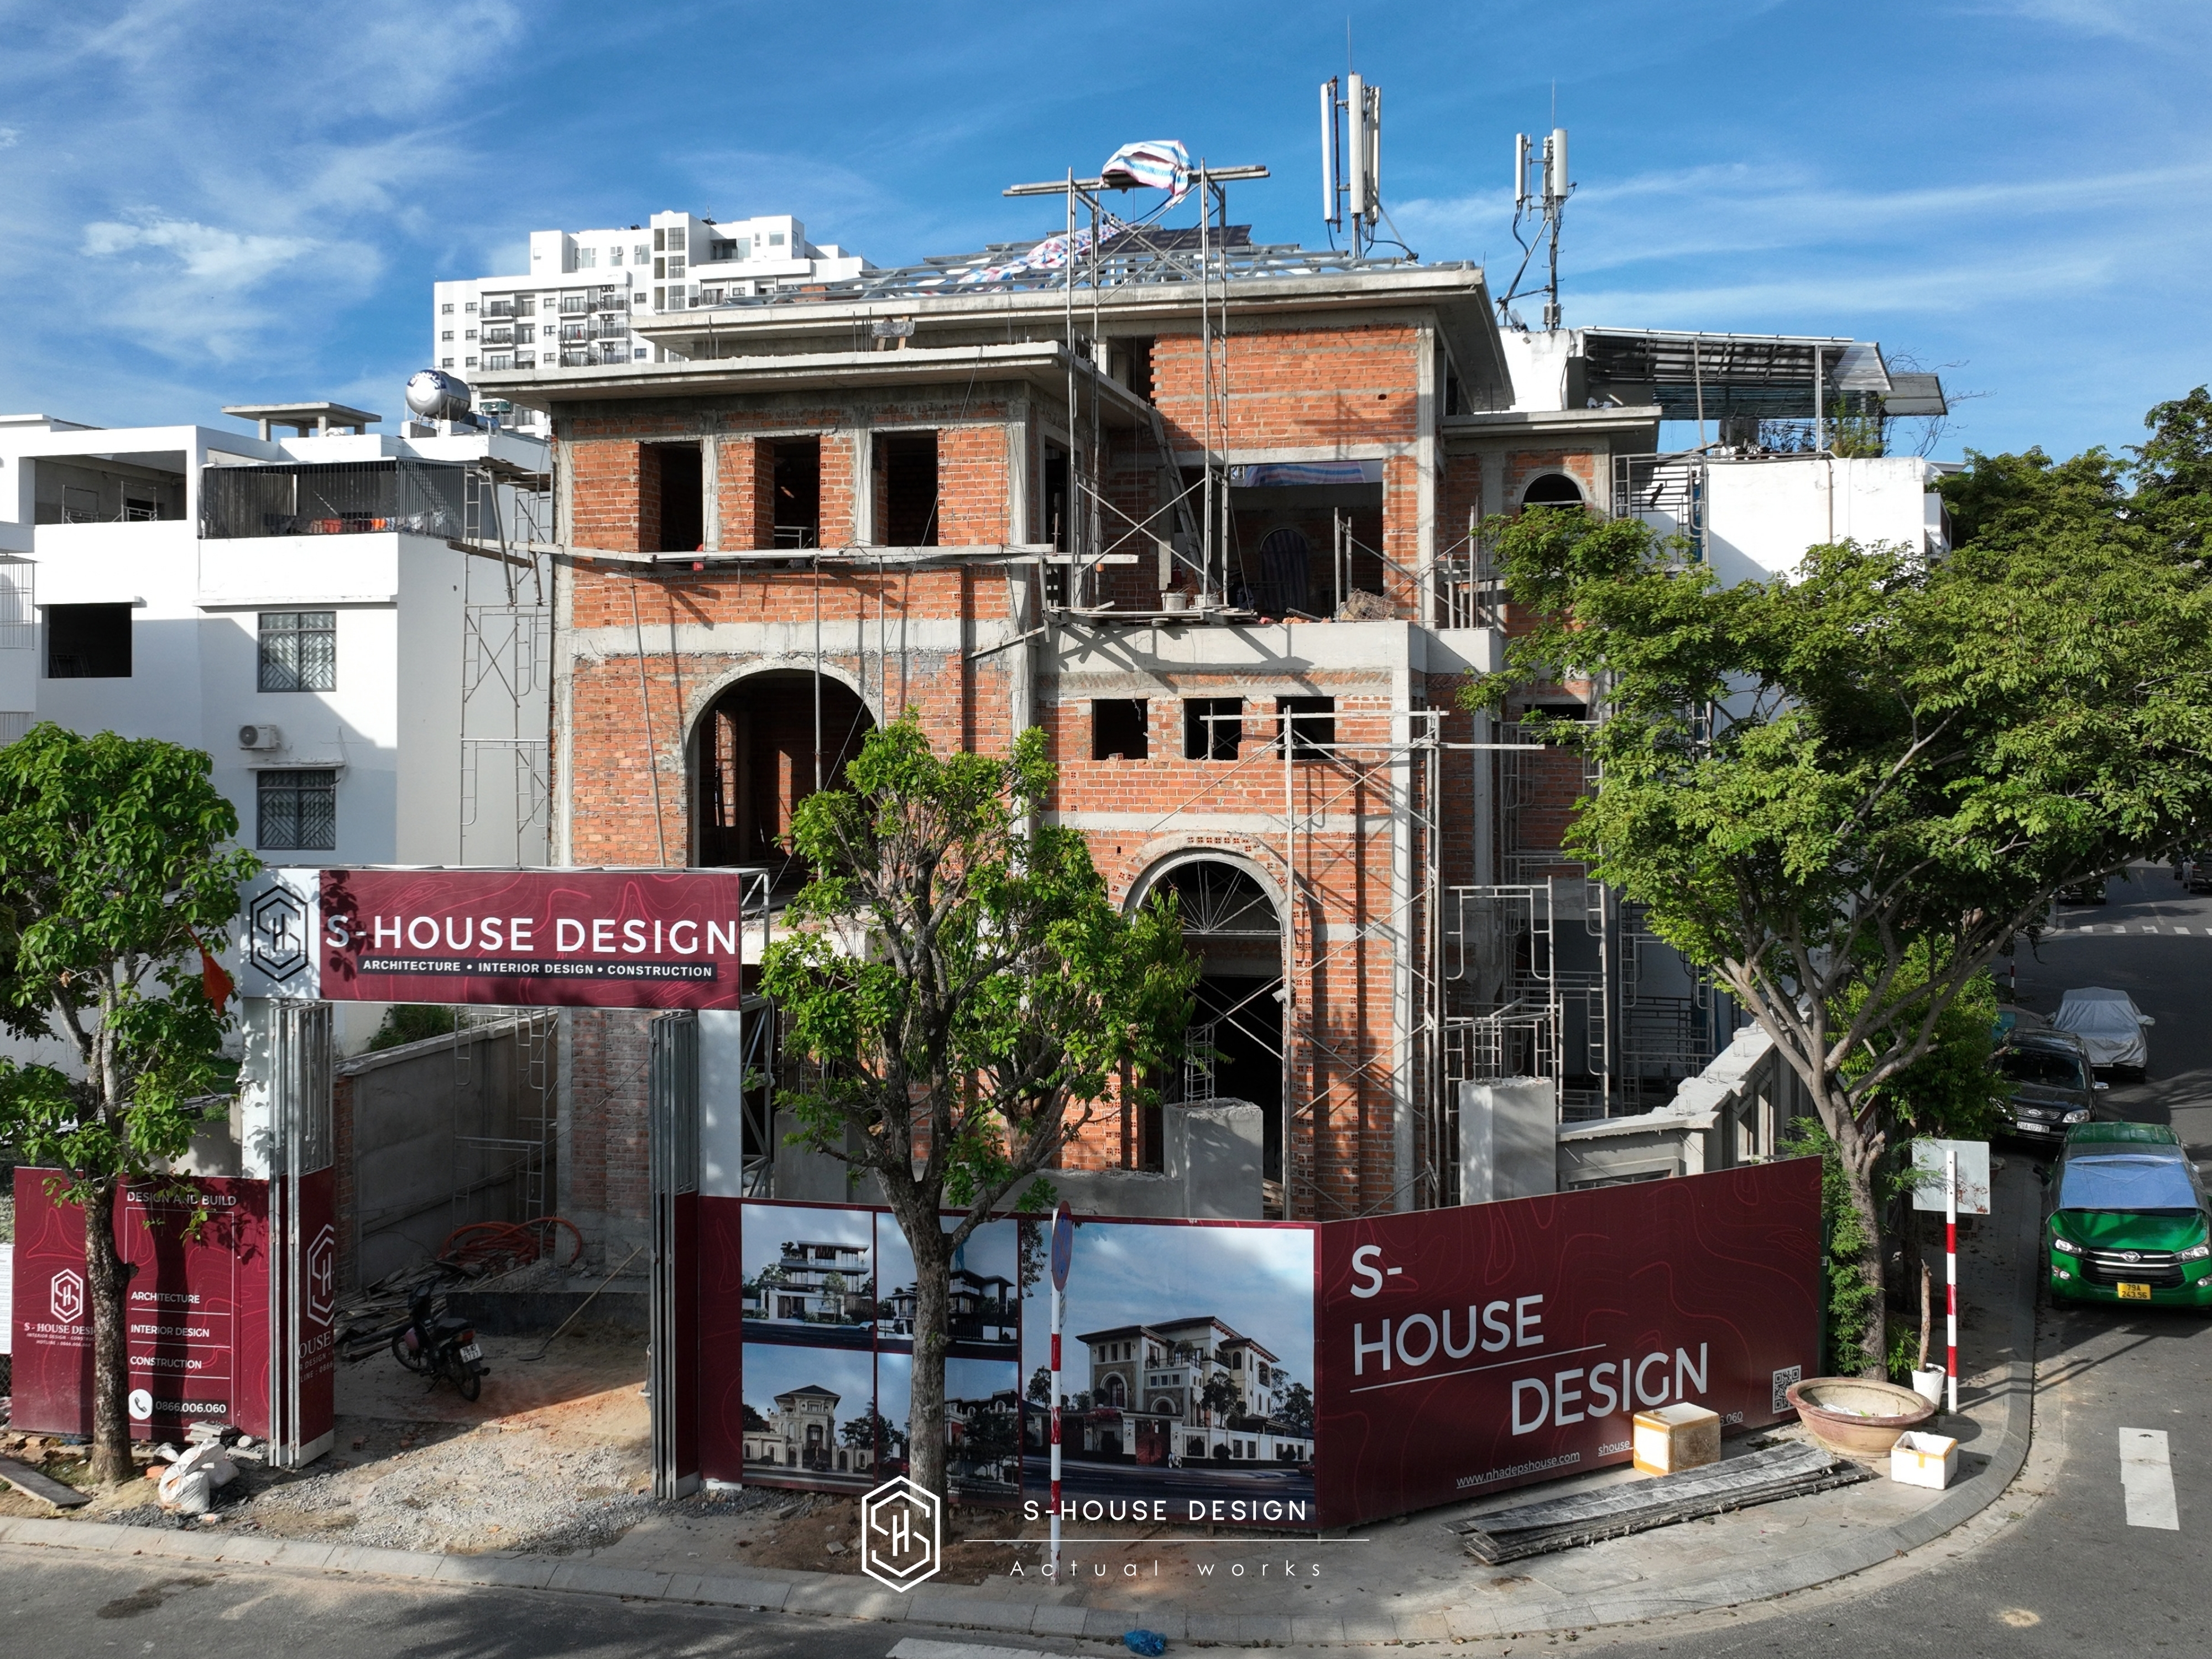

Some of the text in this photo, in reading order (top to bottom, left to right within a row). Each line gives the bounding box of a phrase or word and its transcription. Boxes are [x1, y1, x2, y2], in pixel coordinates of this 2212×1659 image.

[326, 915, 735, 954] S-HOUSE DESIGN
[363, 960, 712, 977] ARCHITECTURE INTERIOR DESIGN CONSTRUCTION
[127, 1192, 237, 1206] DESIGN AND BUILD
[1350, 1245, 1402, 1298] S-
[131, 1291, 200, 1303] ARCHITECTURE
[36, 1323, 70, 1334] HOUSE
[131, 1324, 210, 1337] INTERIOR DESIGN
[1354, 1293, 1544, 1376] HOUSE
[130, 1356, 202, 1369] CONSTRUCTION
[304, 1352, 326, 1369] DESIGN
[1512, 1342, 1708, 1436] DESIGN
[155, 1401, 226, 1413] 0866.006.060
[1726, 1411, 1744, 1424] 060
[1456, 1451, 1580, 1487] www.nhadepshouse.com
